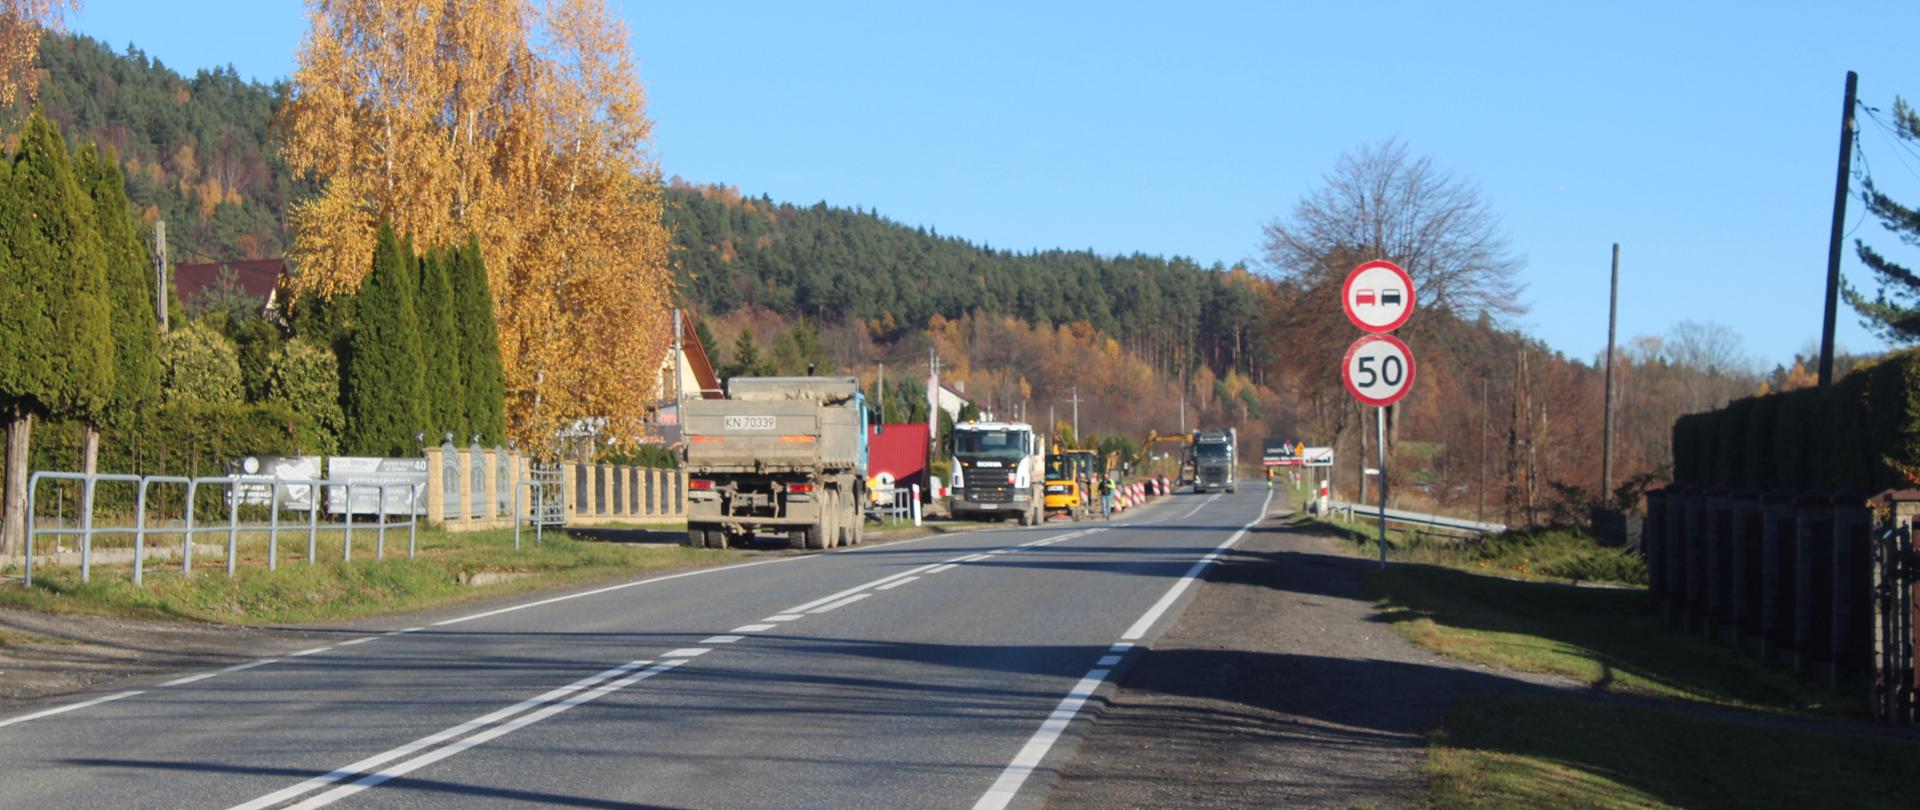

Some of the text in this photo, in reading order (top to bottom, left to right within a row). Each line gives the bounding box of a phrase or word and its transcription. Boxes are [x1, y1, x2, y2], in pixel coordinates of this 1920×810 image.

[1358, 355, 1402, 388] 50
[726, 417, 775, 428] KN 70339
[414, 460, 426, 471] 40
